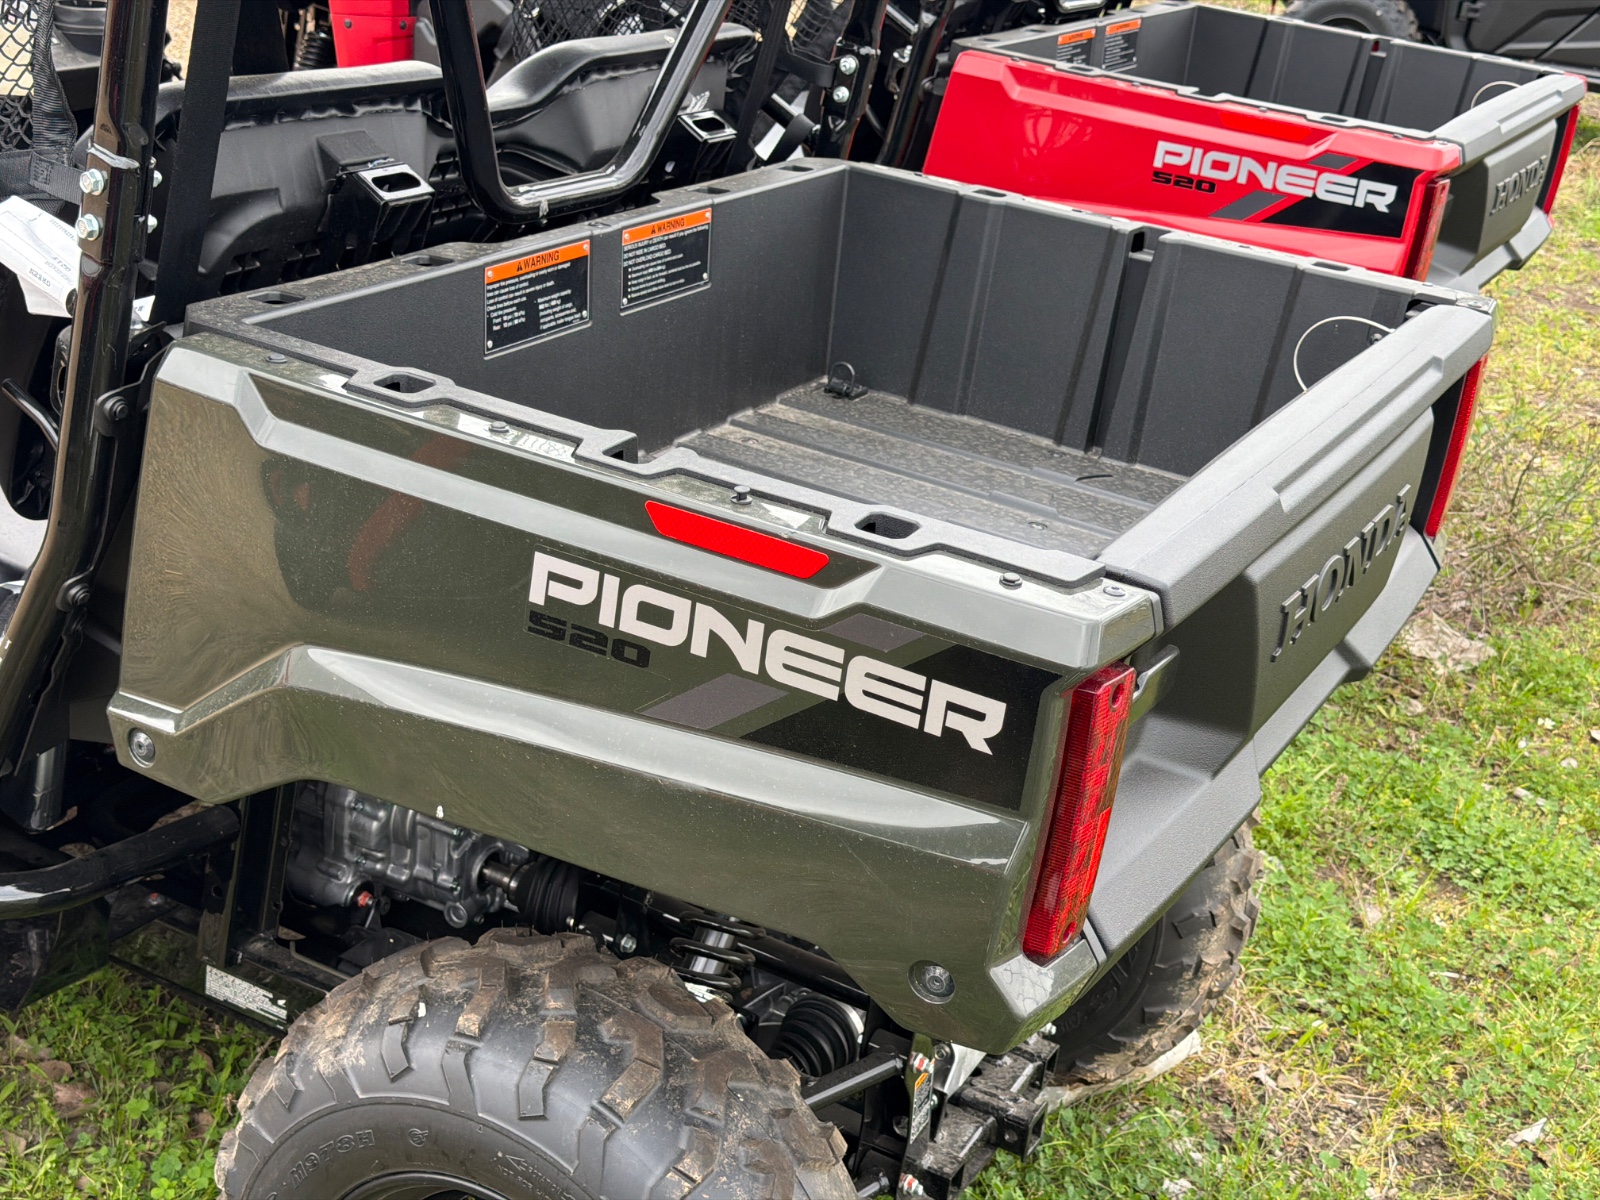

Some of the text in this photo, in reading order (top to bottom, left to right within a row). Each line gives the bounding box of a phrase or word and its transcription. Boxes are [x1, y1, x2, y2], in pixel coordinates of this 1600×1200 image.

[1152, 171, 1216, 193] 520
[1153, 140, 1398, 213] PIONEER
[1489, 155, 1547, 216] HONDA
[657, 218, 684, 232] WARNING
[524, 251, 559, 269] WARNING
[1270, 484, 1411, 662] HONDA
[528, 611, 650, 668] 520
[529, 551, 1006, 755] PIONEER
